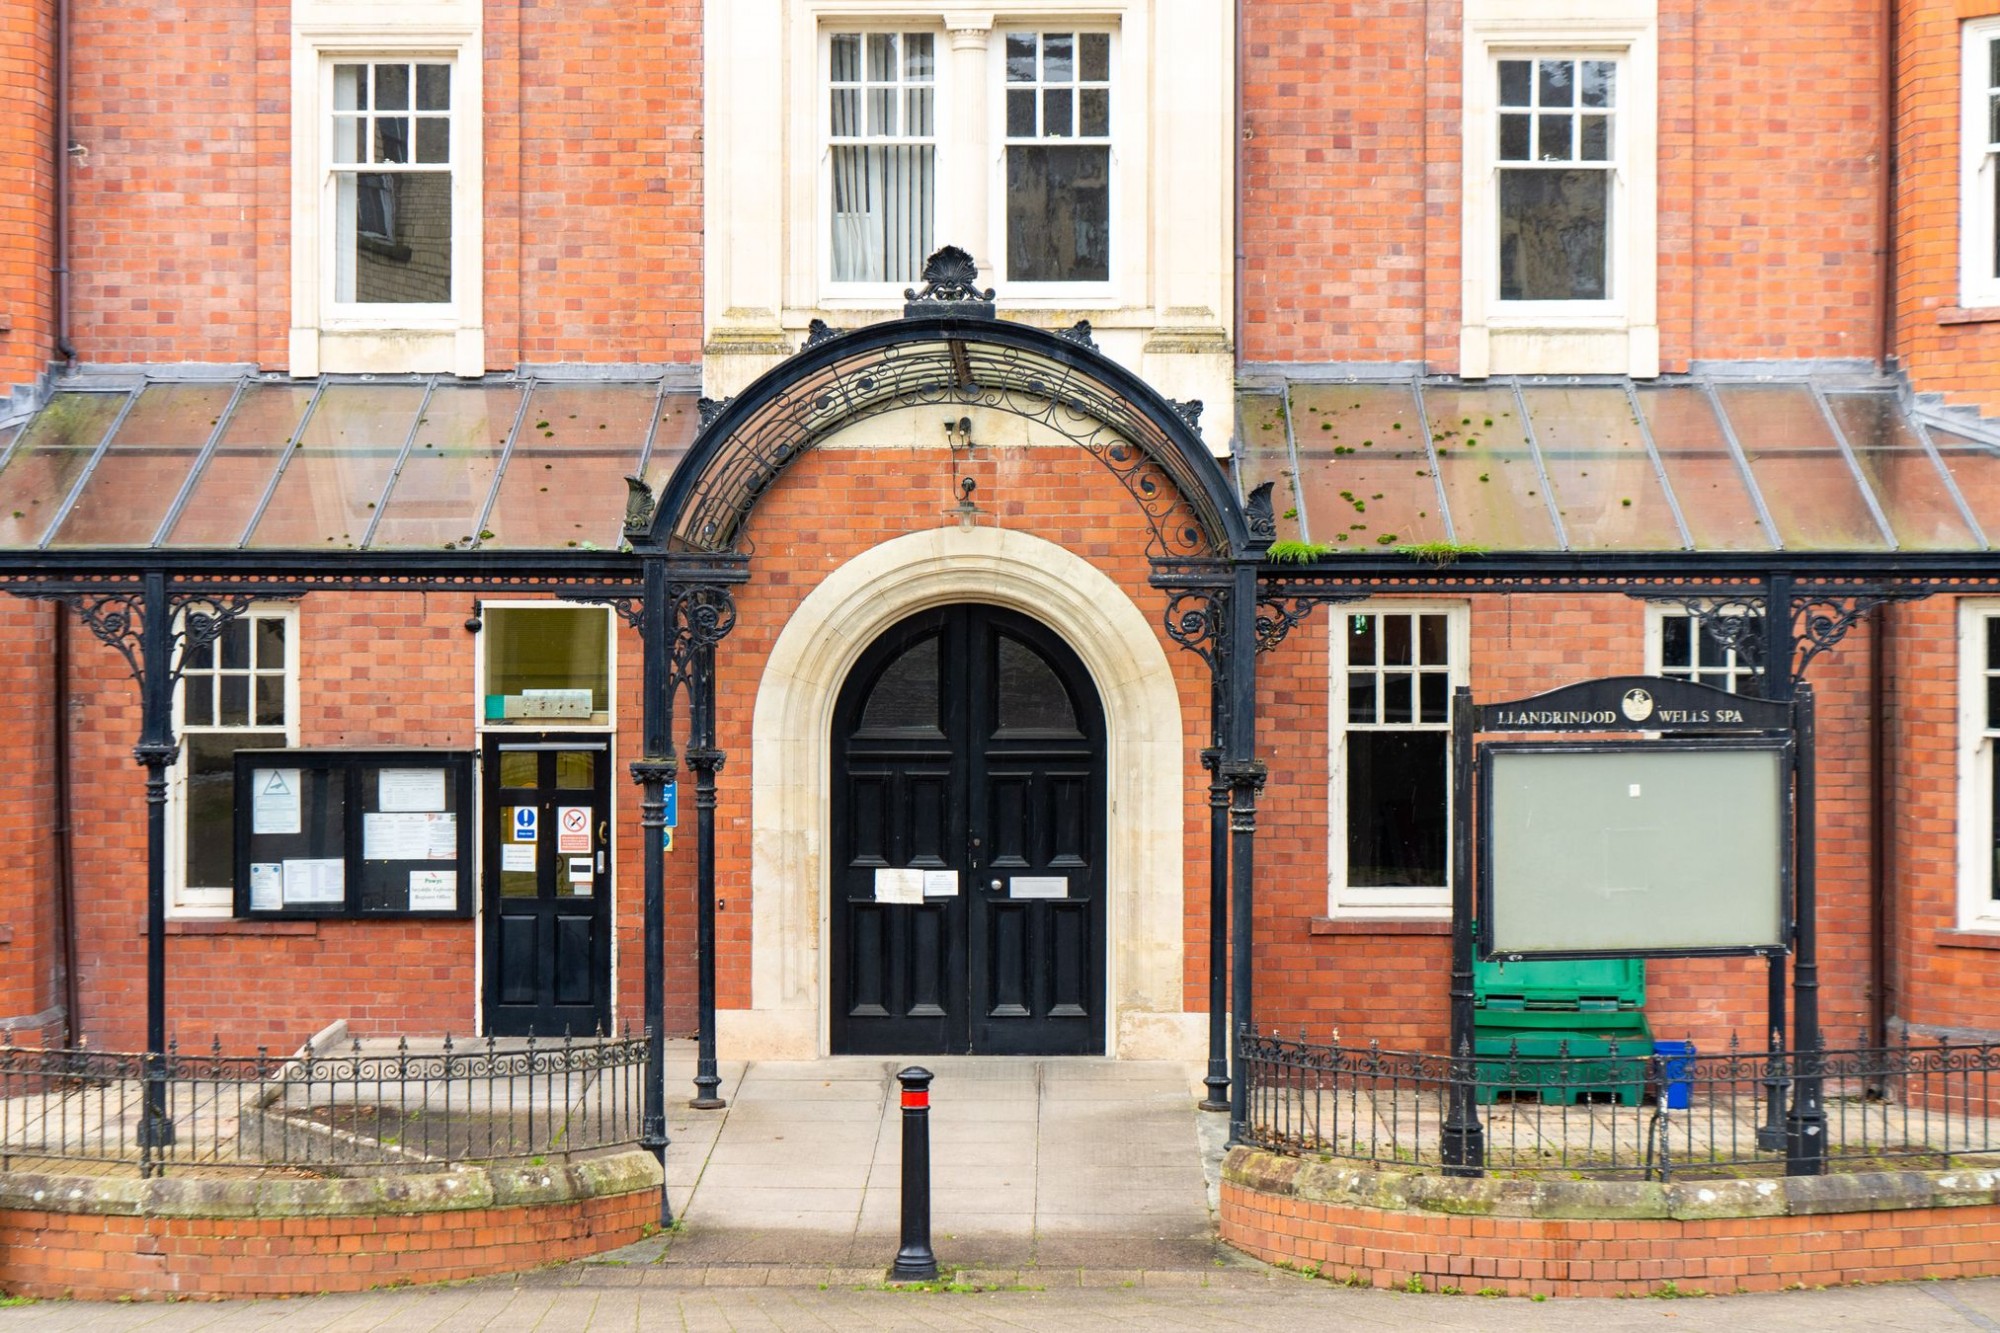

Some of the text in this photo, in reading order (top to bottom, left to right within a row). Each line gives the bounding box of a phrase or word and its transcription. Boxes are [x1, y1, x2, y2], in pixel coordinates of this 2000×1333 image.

[1498, 710, 1744, 724] LLANDRINDOD WELLS SPA
